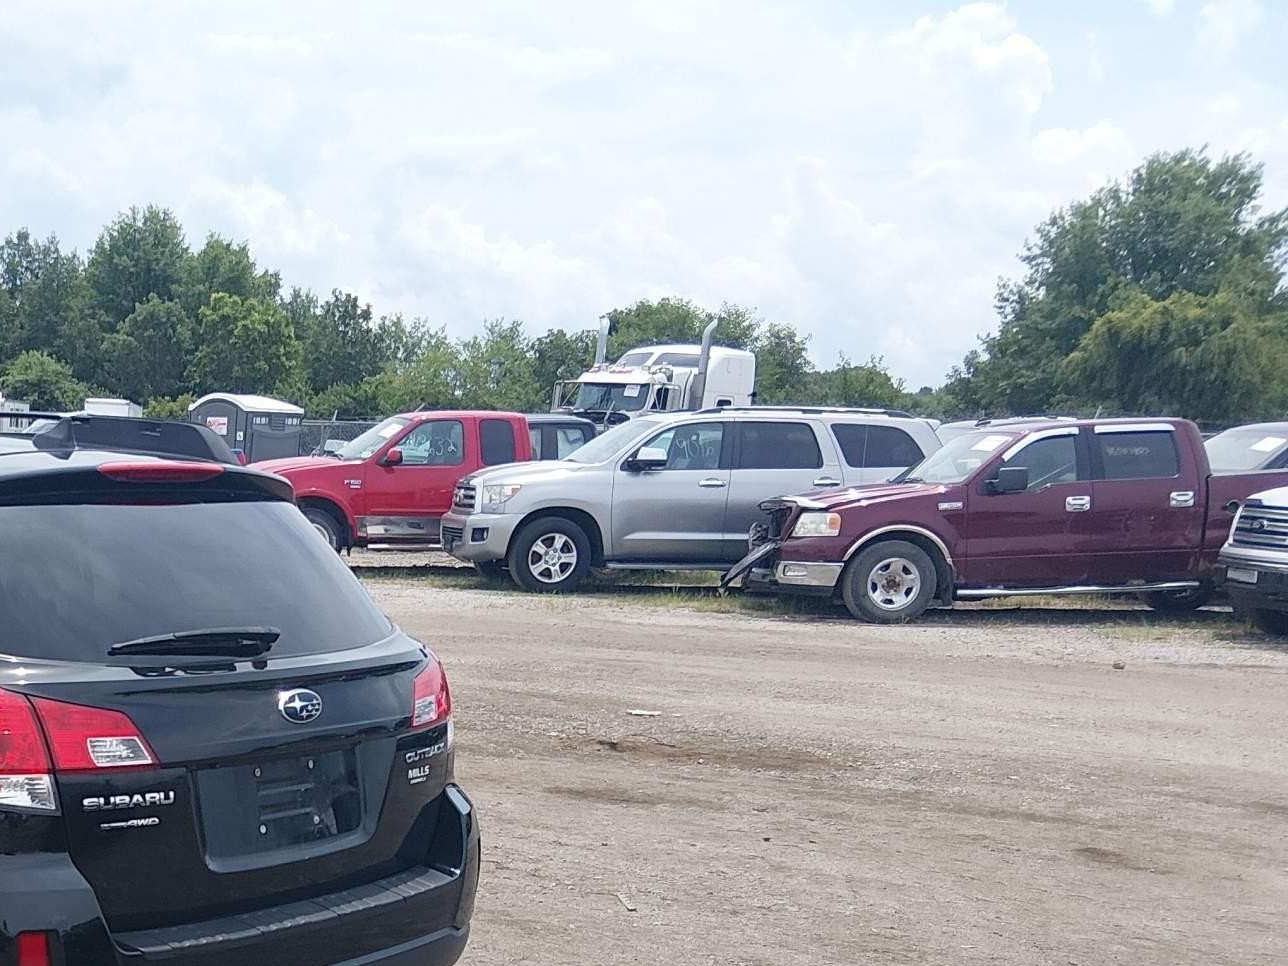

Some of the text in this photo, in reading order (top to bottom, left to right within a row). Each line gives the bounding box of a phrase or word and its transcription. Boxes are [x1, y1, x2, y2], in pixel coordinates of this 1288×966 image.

[407, 765, 430, 779] MILLS
[82, 790, 175, 811] SUBARU
[127, 817, 160, 828] AWD
